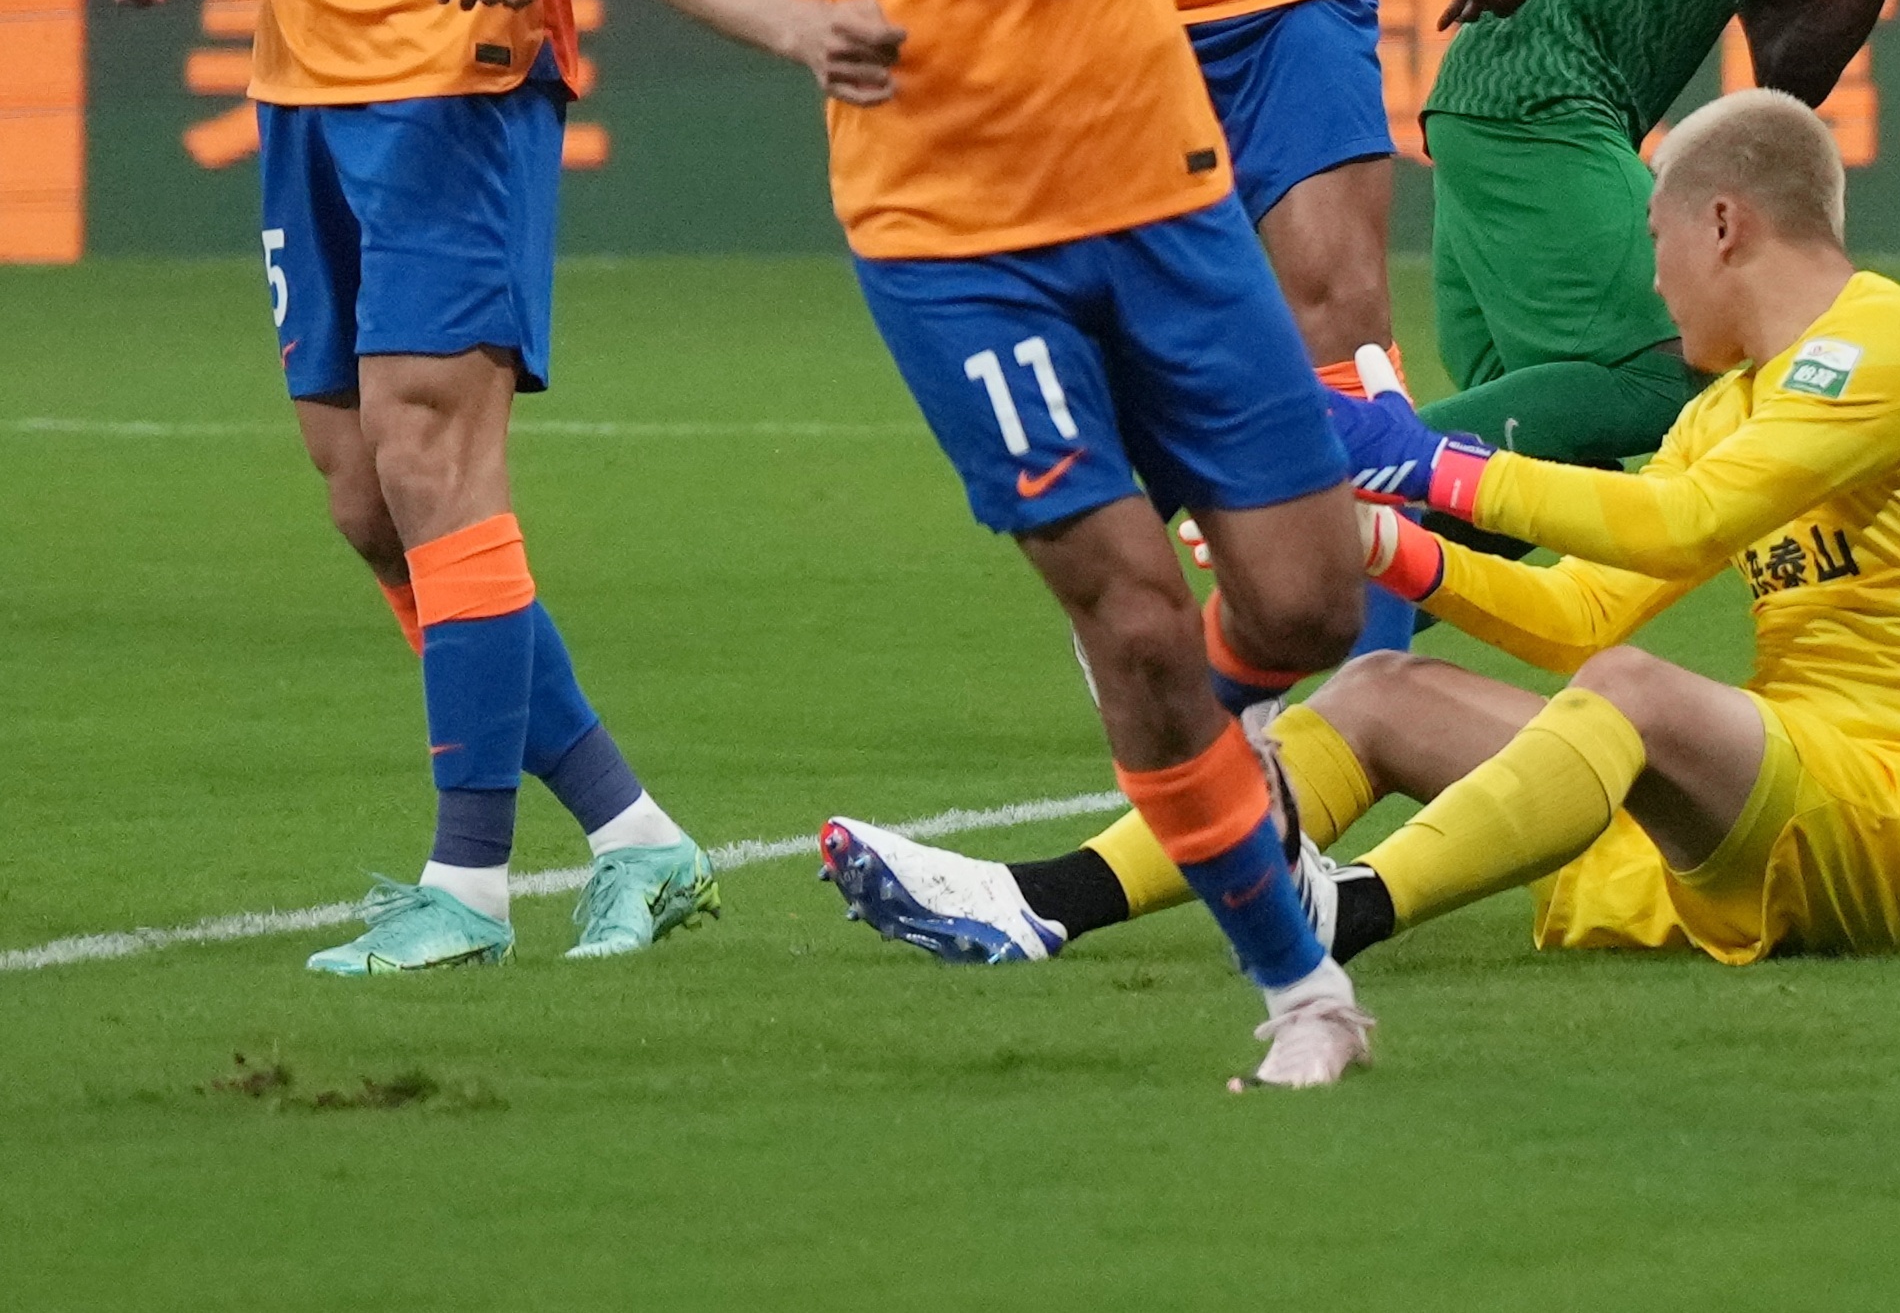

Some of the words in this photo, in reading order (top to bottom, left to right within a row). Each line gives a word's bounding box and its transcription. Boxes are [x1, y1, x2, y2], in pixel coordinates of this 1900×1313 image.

[261, 227, 289, 327] 5
[963, 335, 1079, 456] 11
[1736, 523, 1860, 600] 东泰山
